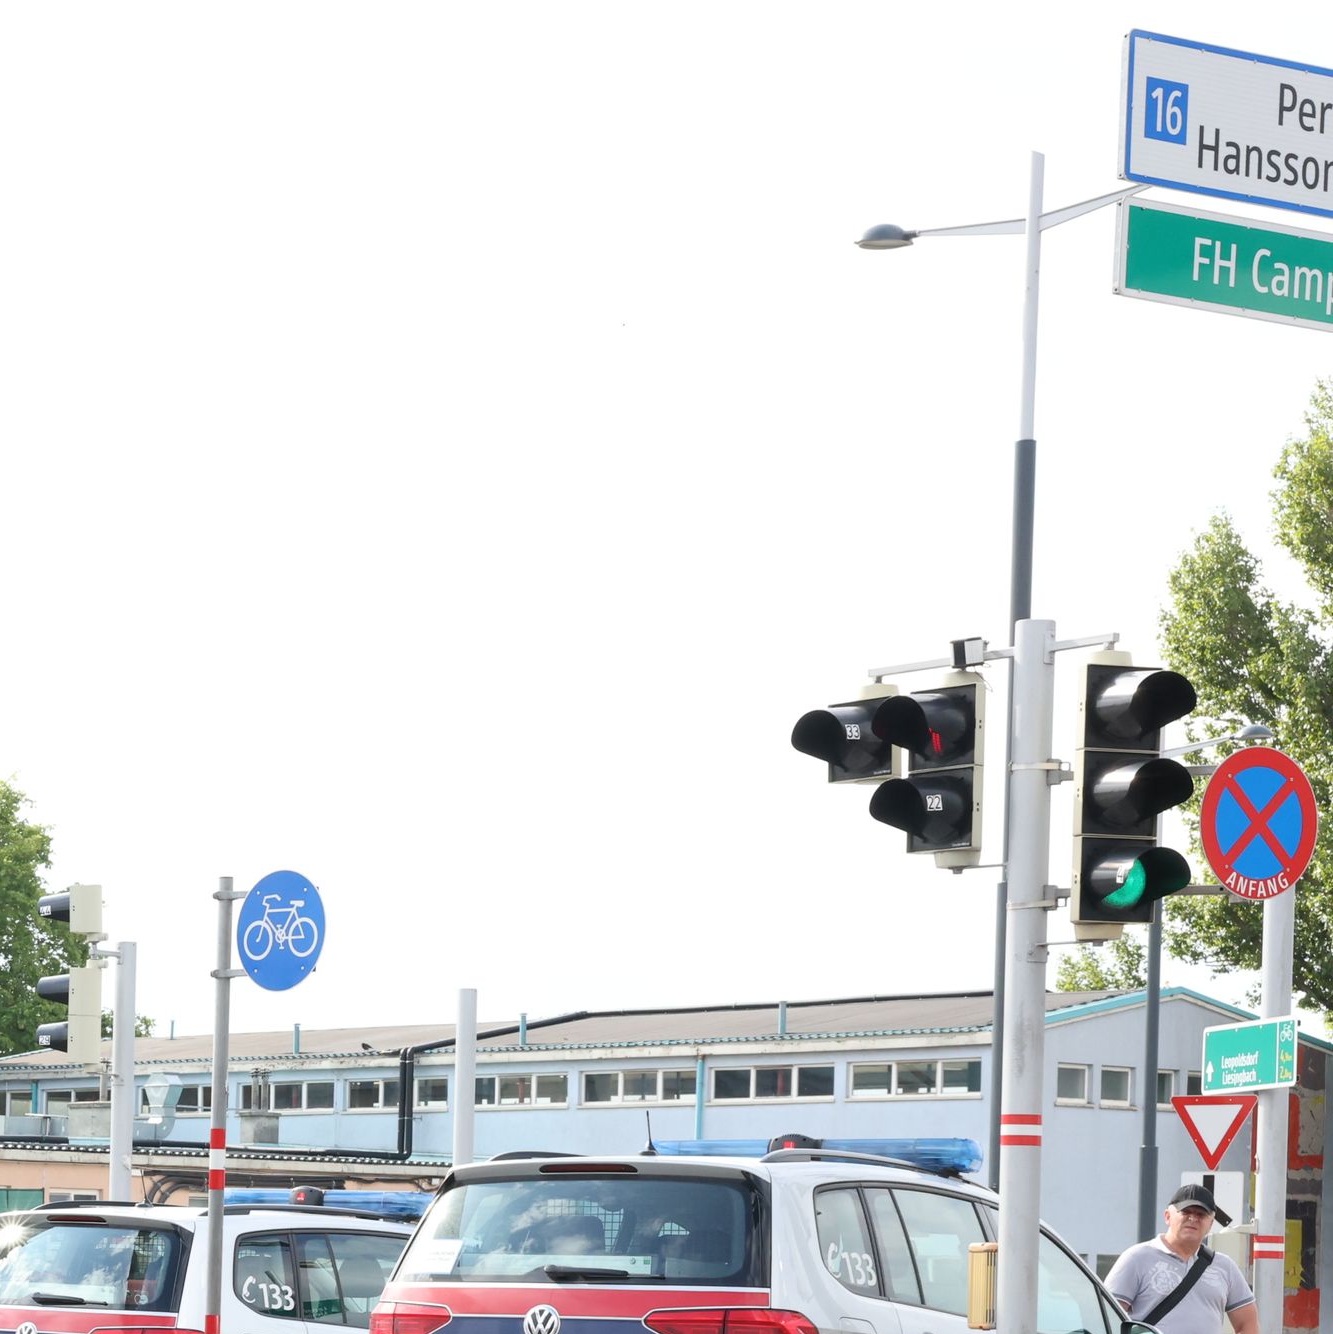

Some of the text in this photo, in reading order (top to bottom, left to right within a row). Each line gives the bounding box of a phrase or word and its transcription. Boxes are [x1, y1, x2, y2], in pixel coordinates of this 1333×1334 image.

[1150, 87, 1183, 136] 16
[1192, 236, 1237, 287] FH
[845, 725, 860, 739] 33
[927, 795, 942, 810] 22
[1225, 871, 1289, 897] ANFANG
[1221, 1051, 1259, 1070] Leopoldsdorf
[1222, 1069, 1256, 1086] Liesingbach
[841, 1252, 877, 1286] 133
[258, 1283, 295, 1311] 133
